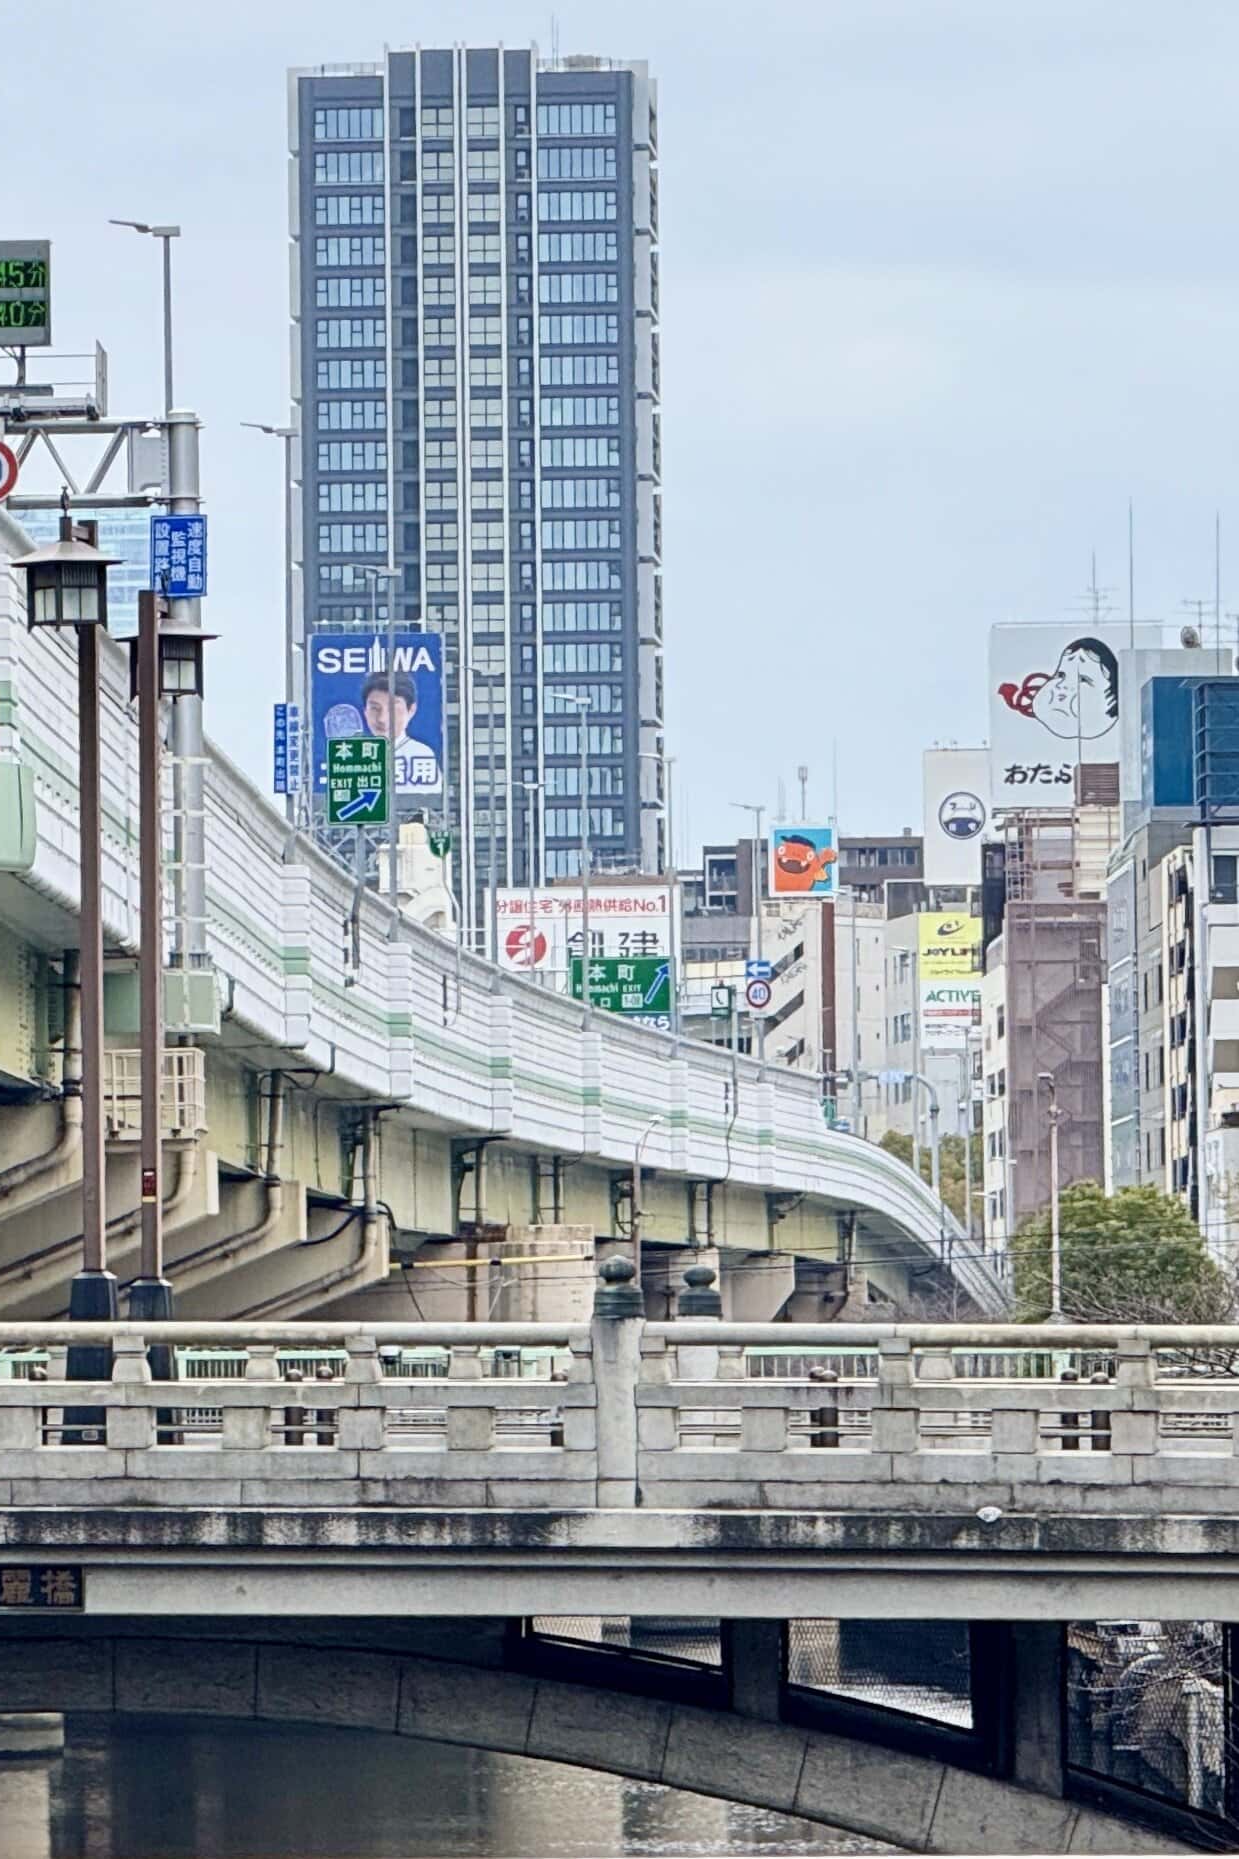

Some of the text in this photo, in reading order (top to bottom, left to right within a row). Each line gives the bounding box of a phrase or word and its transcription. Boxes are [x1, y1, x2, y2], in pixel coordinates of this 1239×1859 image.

[171, 530, 187, 582] 監視機
[187, 521, 203, 590] 速度自動
[336, 741, 380, 760] 本町
[331, 775, 381, 789] EXIT 出口
[588, 964, 635, 981] 本町
[752, 987, 766, 1000] 40
